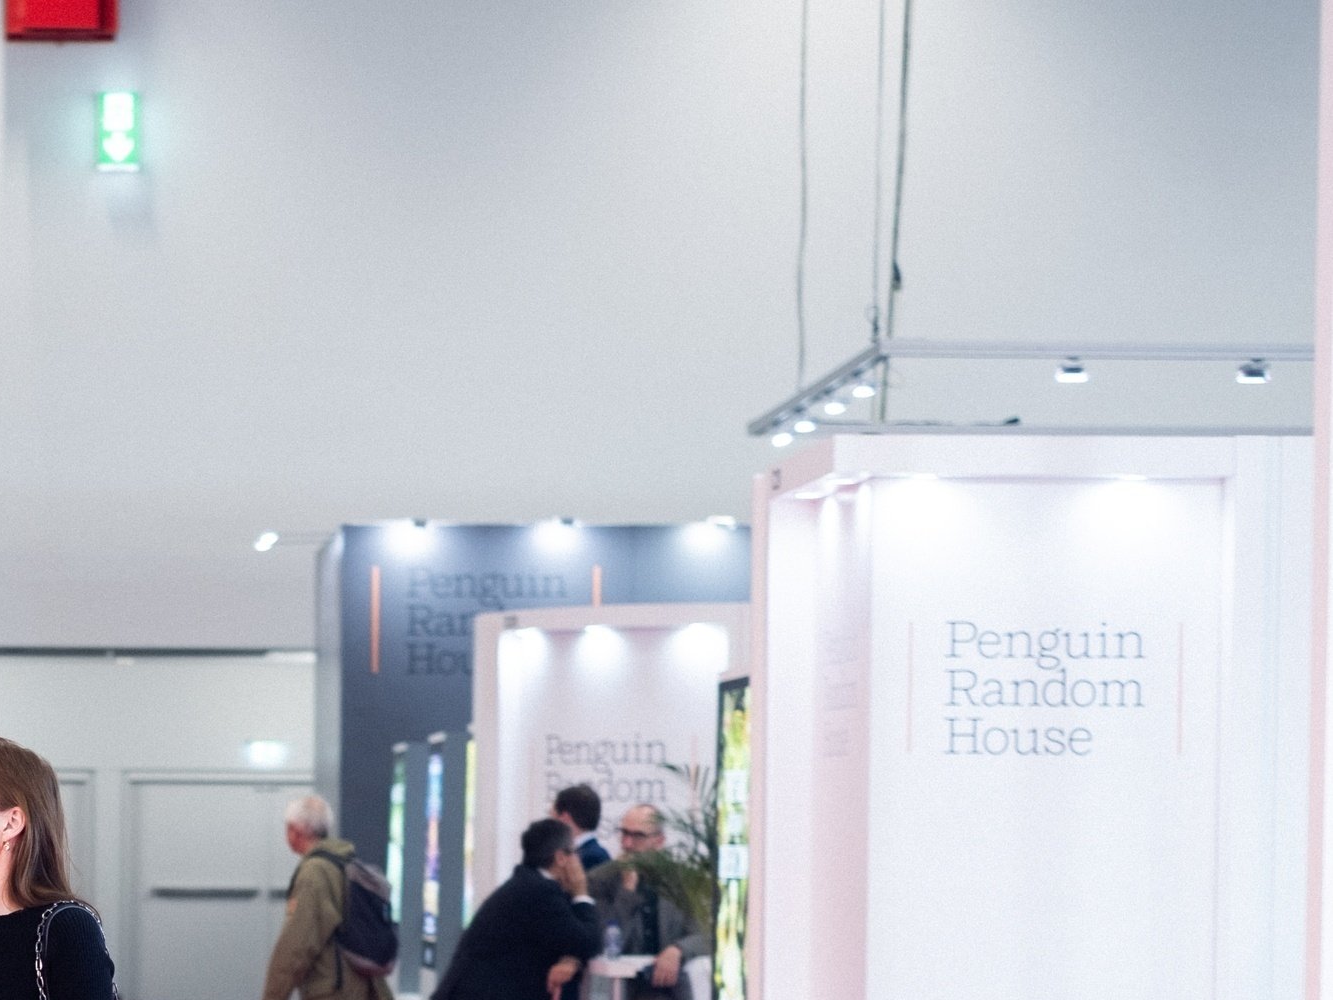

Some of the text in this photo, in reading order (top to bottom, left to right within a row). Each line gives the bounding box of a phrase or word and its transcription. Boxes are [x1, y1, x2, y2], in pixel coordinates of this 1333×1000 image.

[406, 567, 567, 610] Penguin
[944, 620, 1146, 670] Penguin
[944, 668, 1145, 707] Random
[545, 732, 667, 774] Penguin
[944, 716, 1093, 756] House
[545, 768, 667, 803] Rdom
